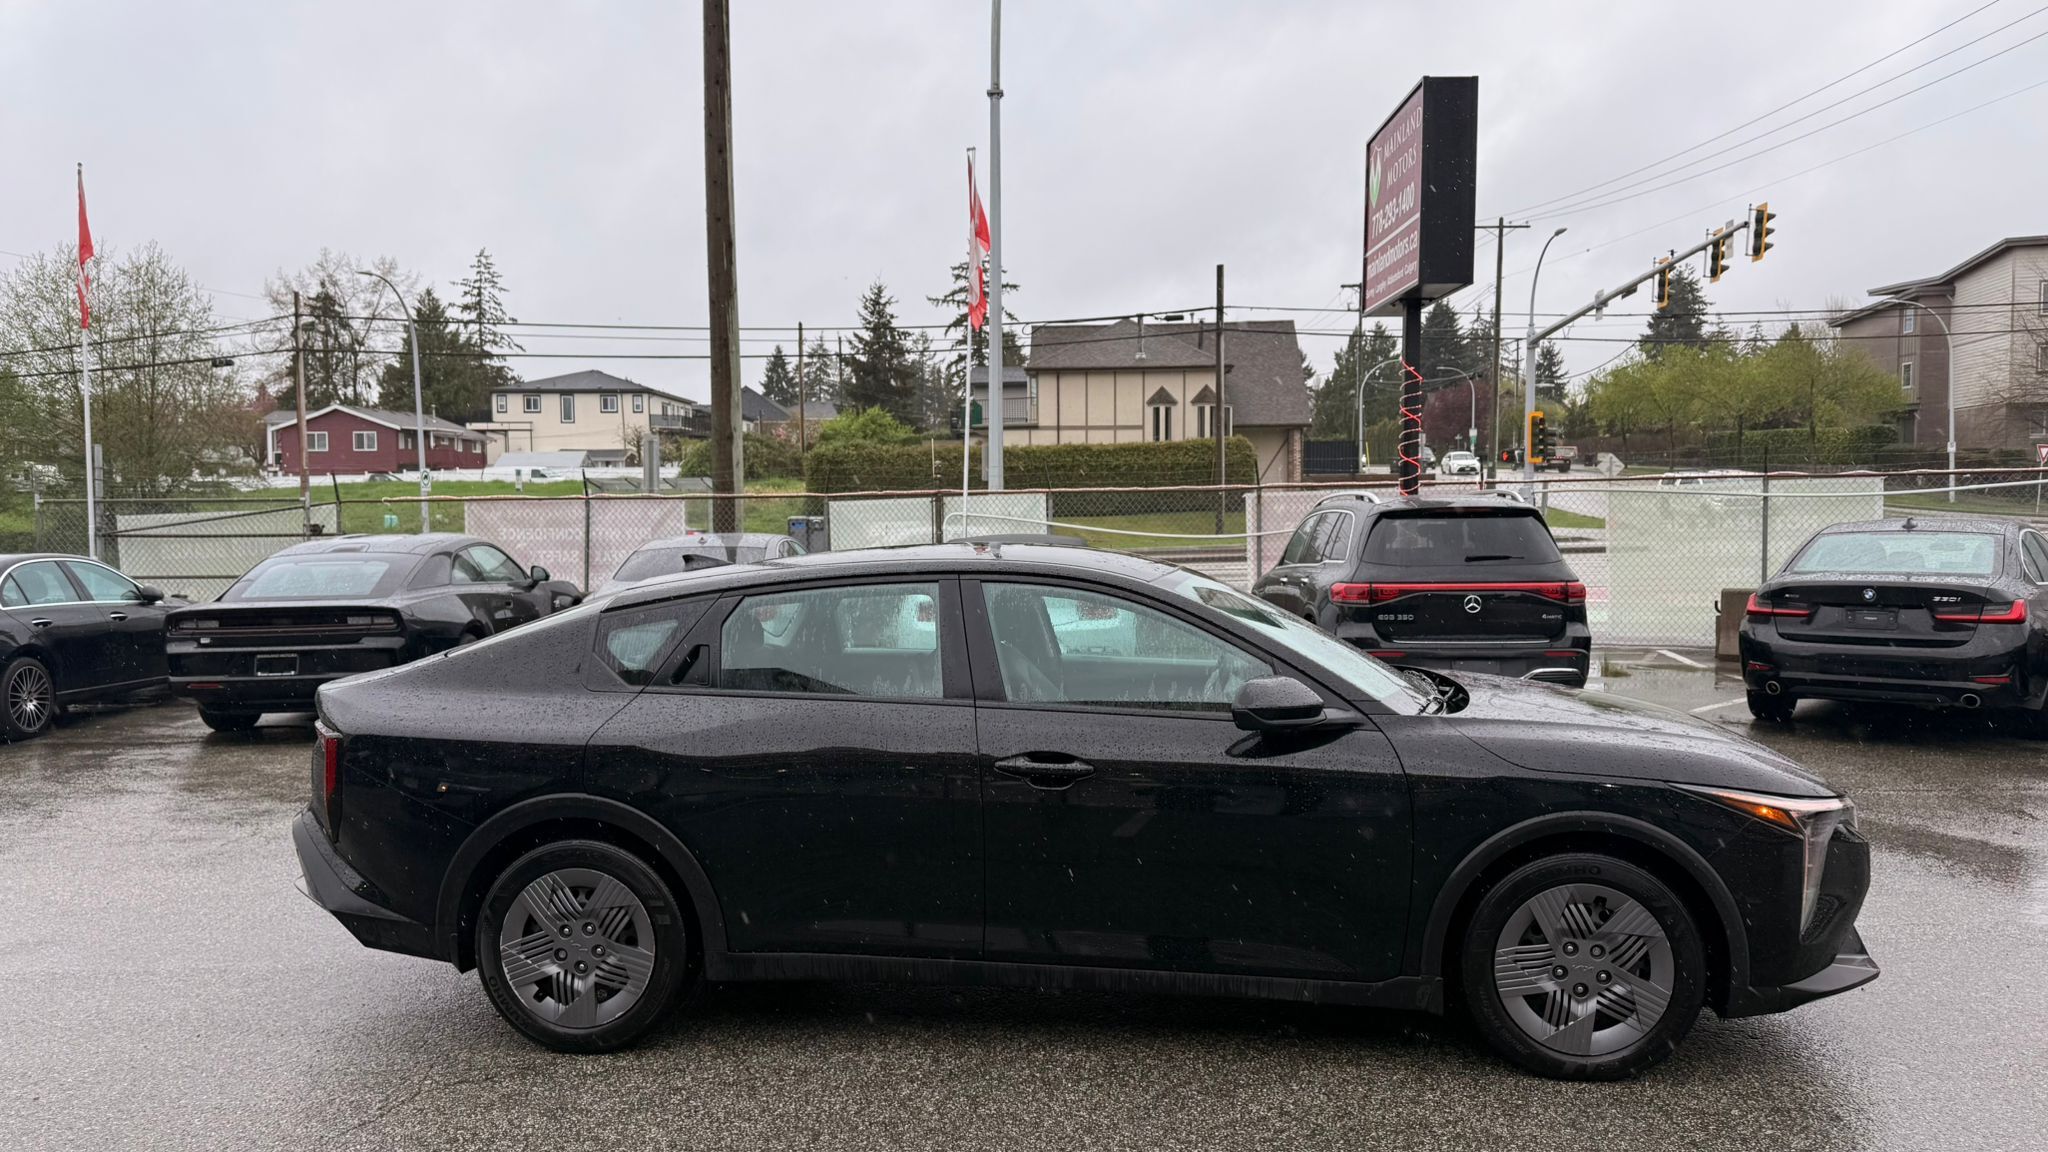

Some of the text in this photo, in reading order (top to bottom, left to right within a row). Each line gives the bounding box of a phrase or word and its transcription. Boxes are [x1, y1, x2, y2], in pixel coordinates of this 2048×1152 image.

[1384, 106, 1422, 161] MAINLAND
[1387, 143, 1417, 190] MOTORS
[1372, 181, 1415, 240] 778-293-1400
